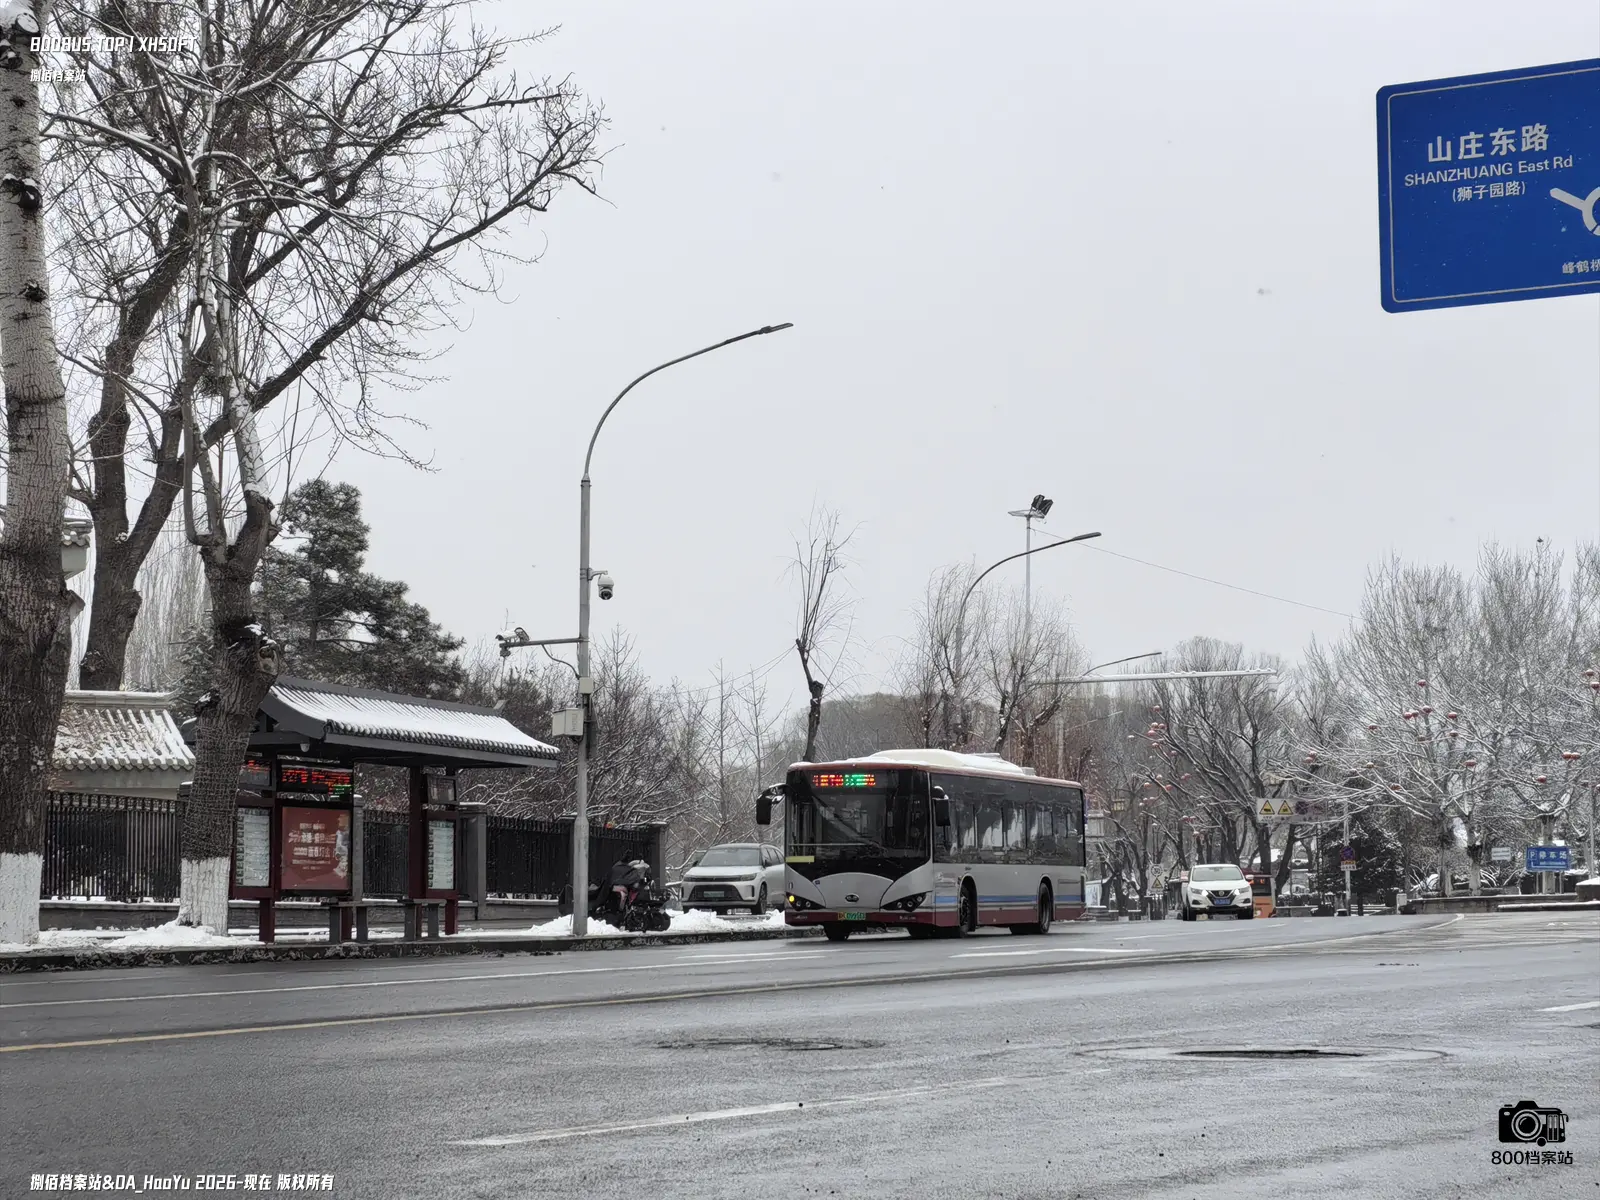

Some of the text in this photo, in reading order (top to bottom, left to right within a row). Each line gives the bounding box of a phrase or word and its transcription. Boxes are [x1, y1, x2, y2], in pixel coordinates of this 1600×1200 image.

[1427, 122, 1550, 163] 山庄东路
[1404, 155, 1574, 187] SHANZHUANG East Rd
[1452, 181, 1526, 202] (狮子园路)
